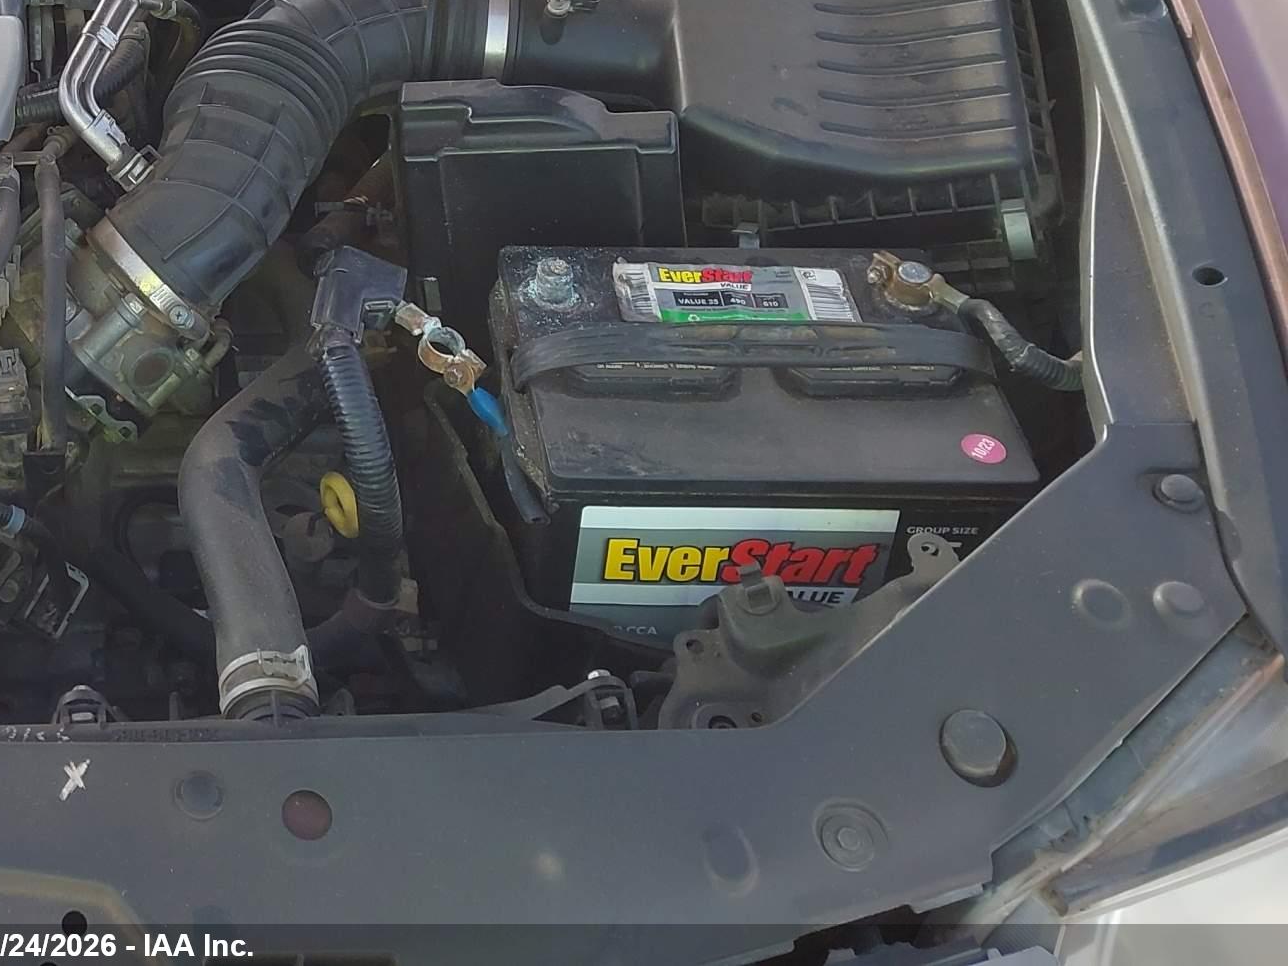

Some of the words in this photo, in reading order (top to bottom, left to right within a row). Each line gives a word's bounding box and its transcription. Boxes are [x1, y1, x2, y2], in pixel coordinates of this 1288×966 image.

[657, 266, 754, 283] EverStart
[720, 282, 749, 290] VALUE
[678, 297, 707, 305] VALUE
[971, 438, 996, 459] 10/23
[906, 526, 951, 535] GROUP
[952, 526, 980, 535] SIZE
[603, 538, 879, 586] EverStart
[785, 590, 843, 604] ALUE
